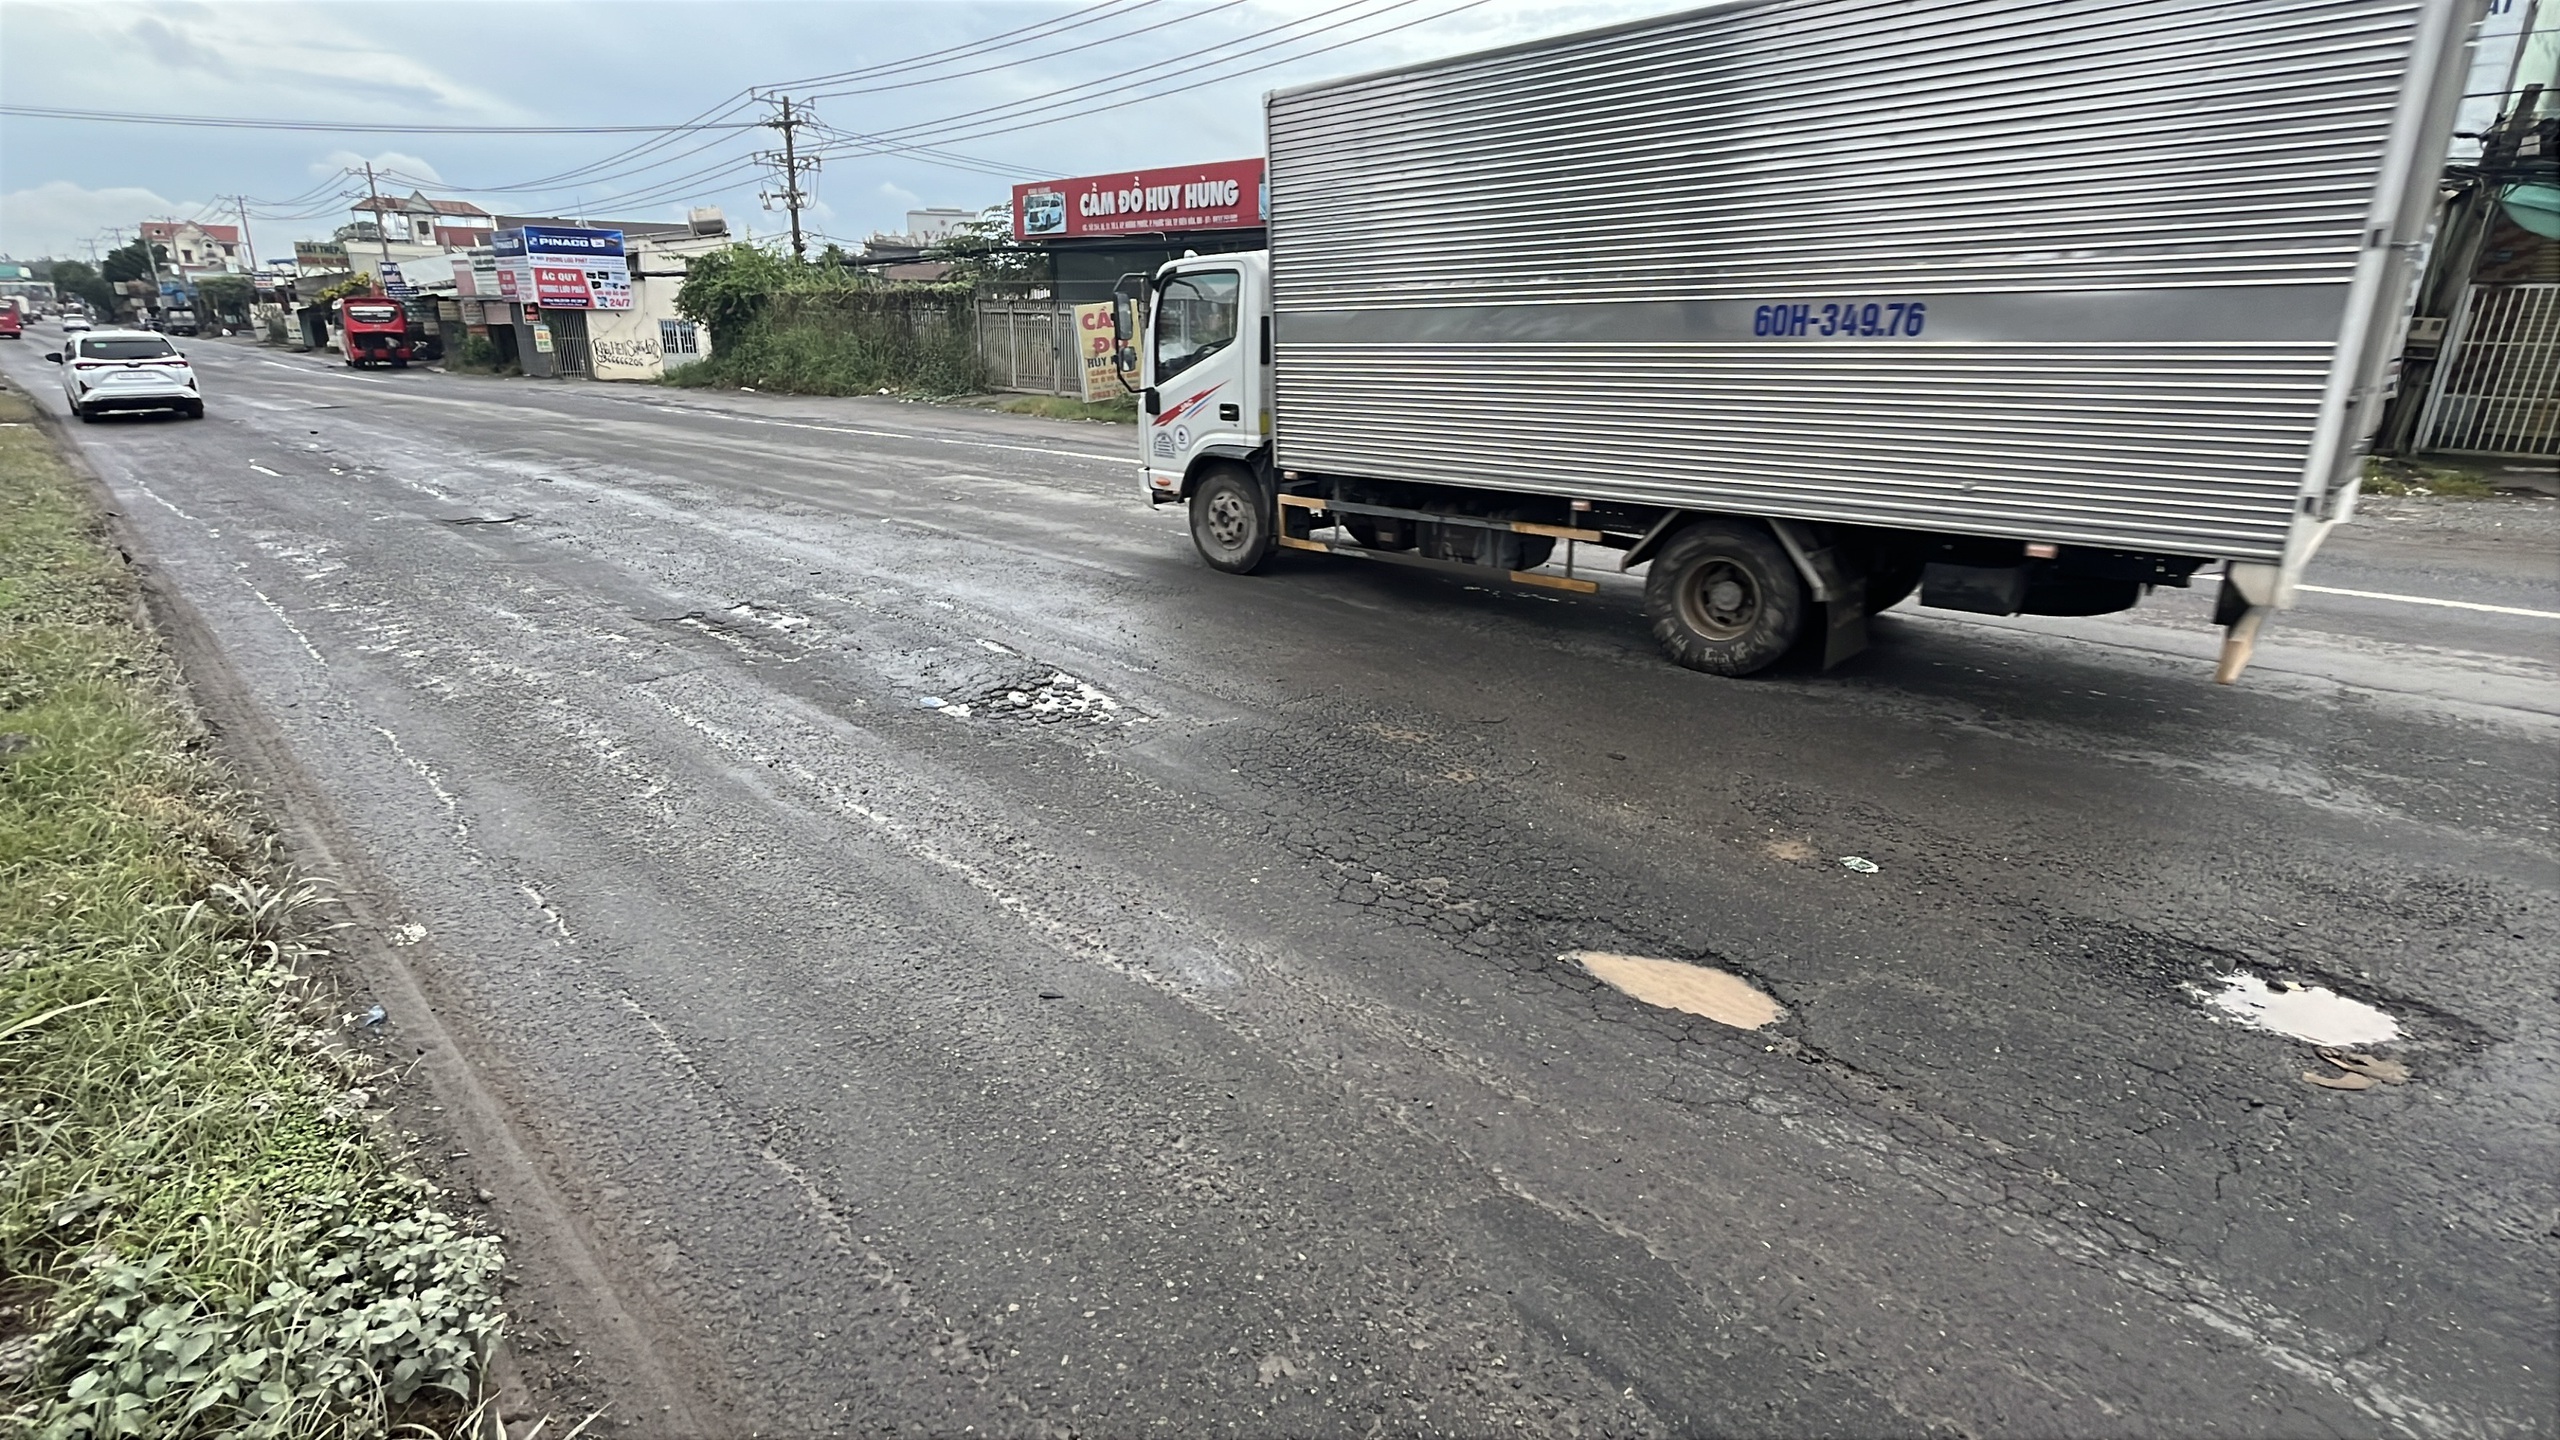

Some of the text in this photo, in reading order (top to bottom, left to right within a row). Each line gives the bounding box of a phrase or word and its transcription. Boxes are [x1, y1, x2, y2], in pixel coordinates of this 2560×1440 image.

[1079, 175, 1239, 217] CẦM ĐỒ HUY HÙNG
[539, 238, 589, 247] PINACO
[609, 299, 630, 307] 24/7
[1082, 306, 1115, 330] CẦ
[1754, 302, 1927, 337] 60H-349.76
[1087, 357, 1107, 368] HUY
